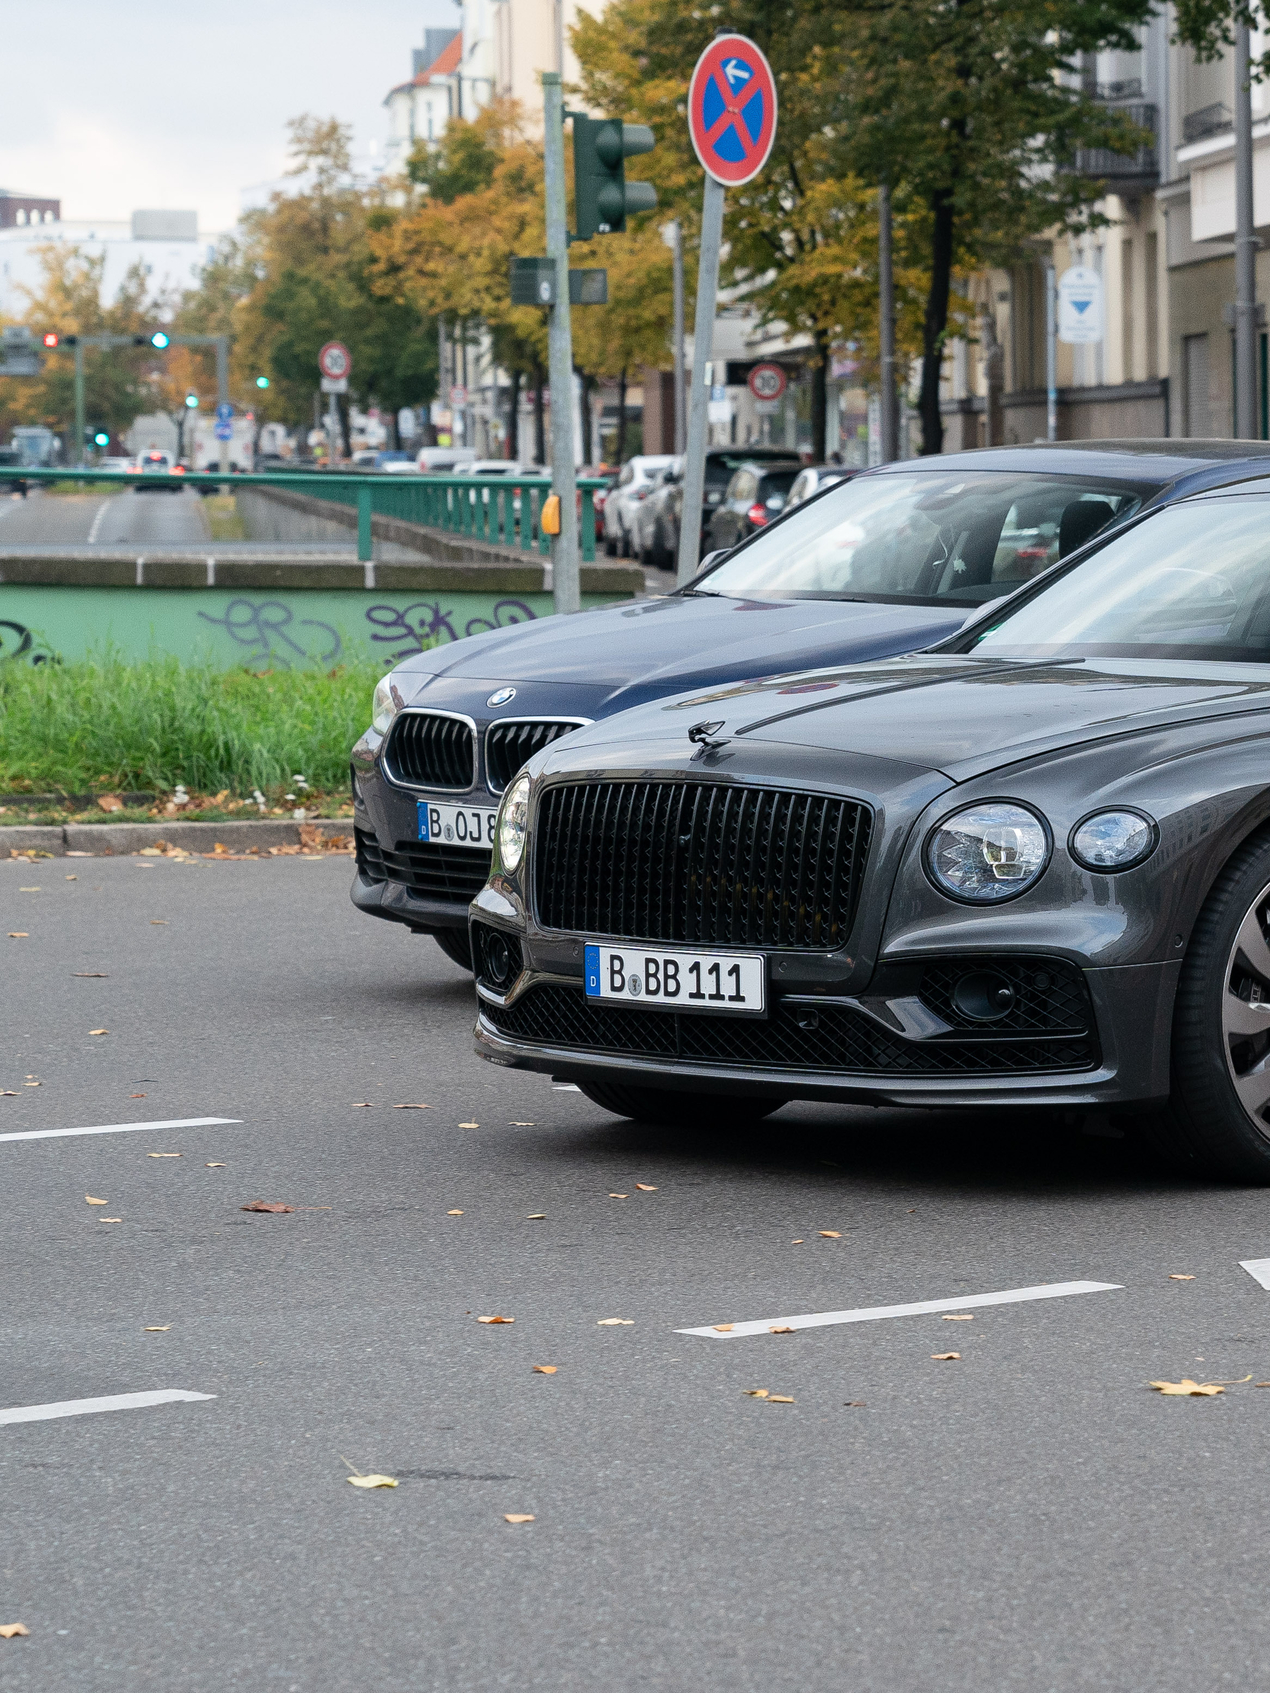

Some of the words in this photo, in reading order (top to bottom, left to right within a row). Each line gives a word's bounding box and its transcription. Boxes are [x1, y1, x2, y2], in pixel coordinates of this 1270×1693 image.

[429, 808, 442, 838] B
[590, 976, 597, 987] D
[609, 954, 626, 993] B
